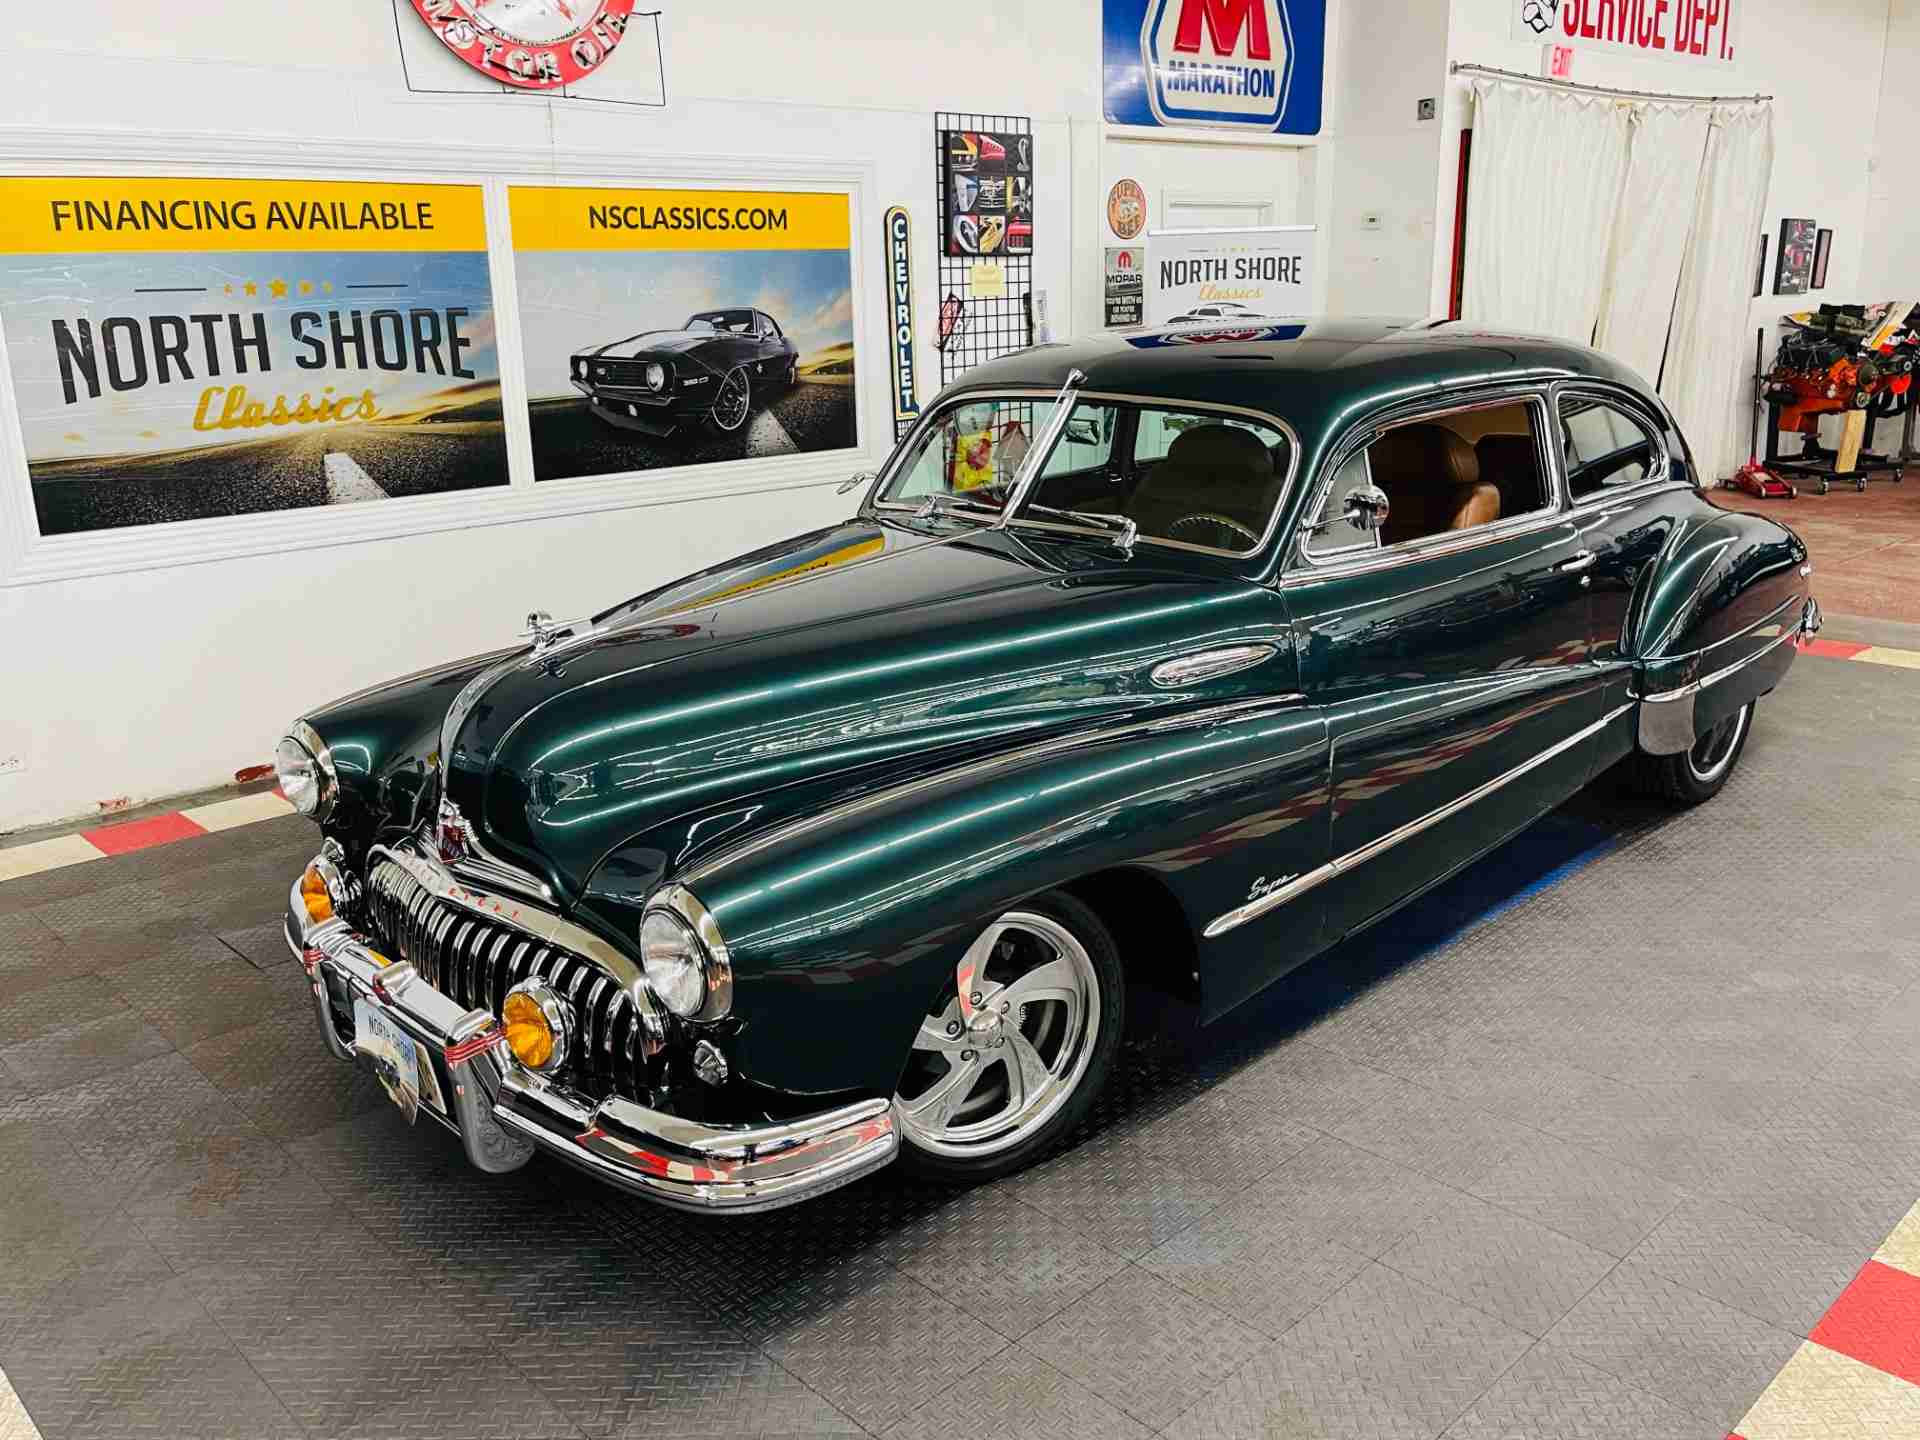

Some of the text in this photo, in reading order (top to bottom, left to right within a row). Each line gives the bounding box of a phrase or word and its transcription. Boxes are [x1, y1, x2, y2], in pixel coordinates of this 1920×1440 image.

[1167, 60, 1275, 98] MARATHON
[1551, 46, 1572, 76] EXIT
[51, 199, 435, 232] FINANCING AVAILABLE
[588, 204, 788, 231] NSCLASSICS.COM
[1160, 256, 1302, 290] NORTH SHORE
[893, 218, 914, 410] CHEVROLET
[51, 306, 477, 405] NORTH SHORE
[192, 384, 383, 433] Classics
